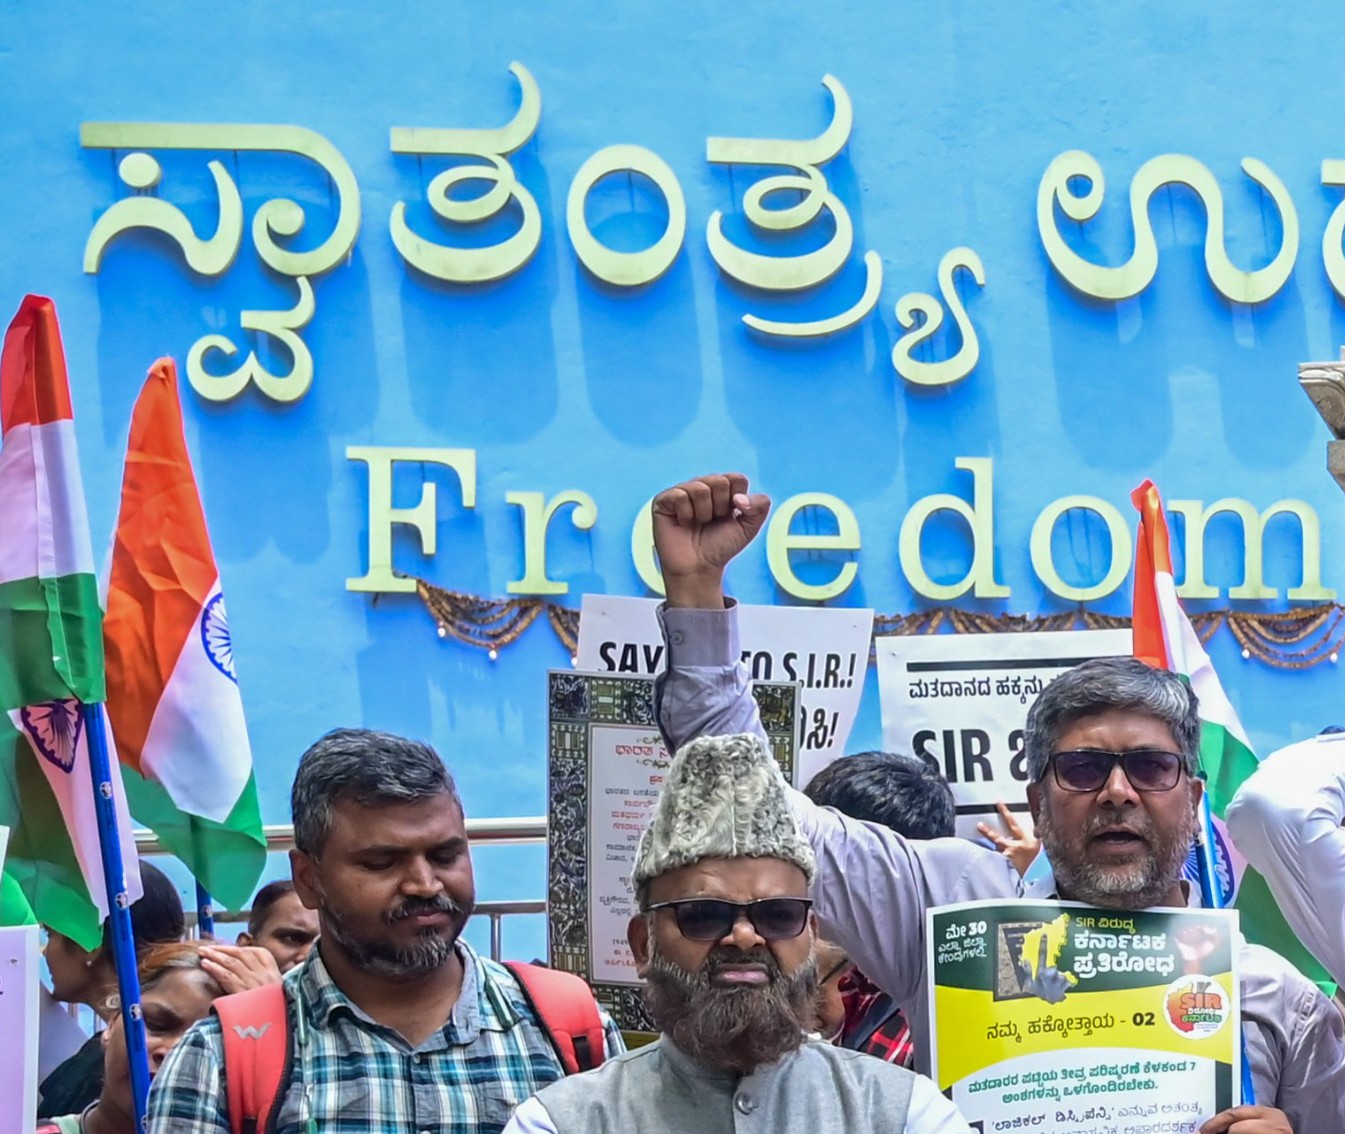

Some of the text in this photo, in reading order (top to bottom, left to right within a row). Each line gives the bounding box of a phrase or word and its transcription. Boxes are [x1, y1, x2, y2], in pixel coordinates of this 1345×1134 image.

[80, 60, 985, 403] ಸ್ವಾತಂತ್ರ್ಯ
[346, 447, 1337, 603] Fredom
[908, 678, 992, 699] ಮತದಾನದ
[913, 728, 994, 785] SIR
[945, 921, 987, 939] ಮೇ 30
[1072, 916, 1095, 931] SIR
[1072, 931, 1168, 951] ಕರ್ನಾಟಕ
[1072, 953, 1177, 979] ಪ್ರತಿರೋಧ
[1180, 992, 1222, 1009] SIR
